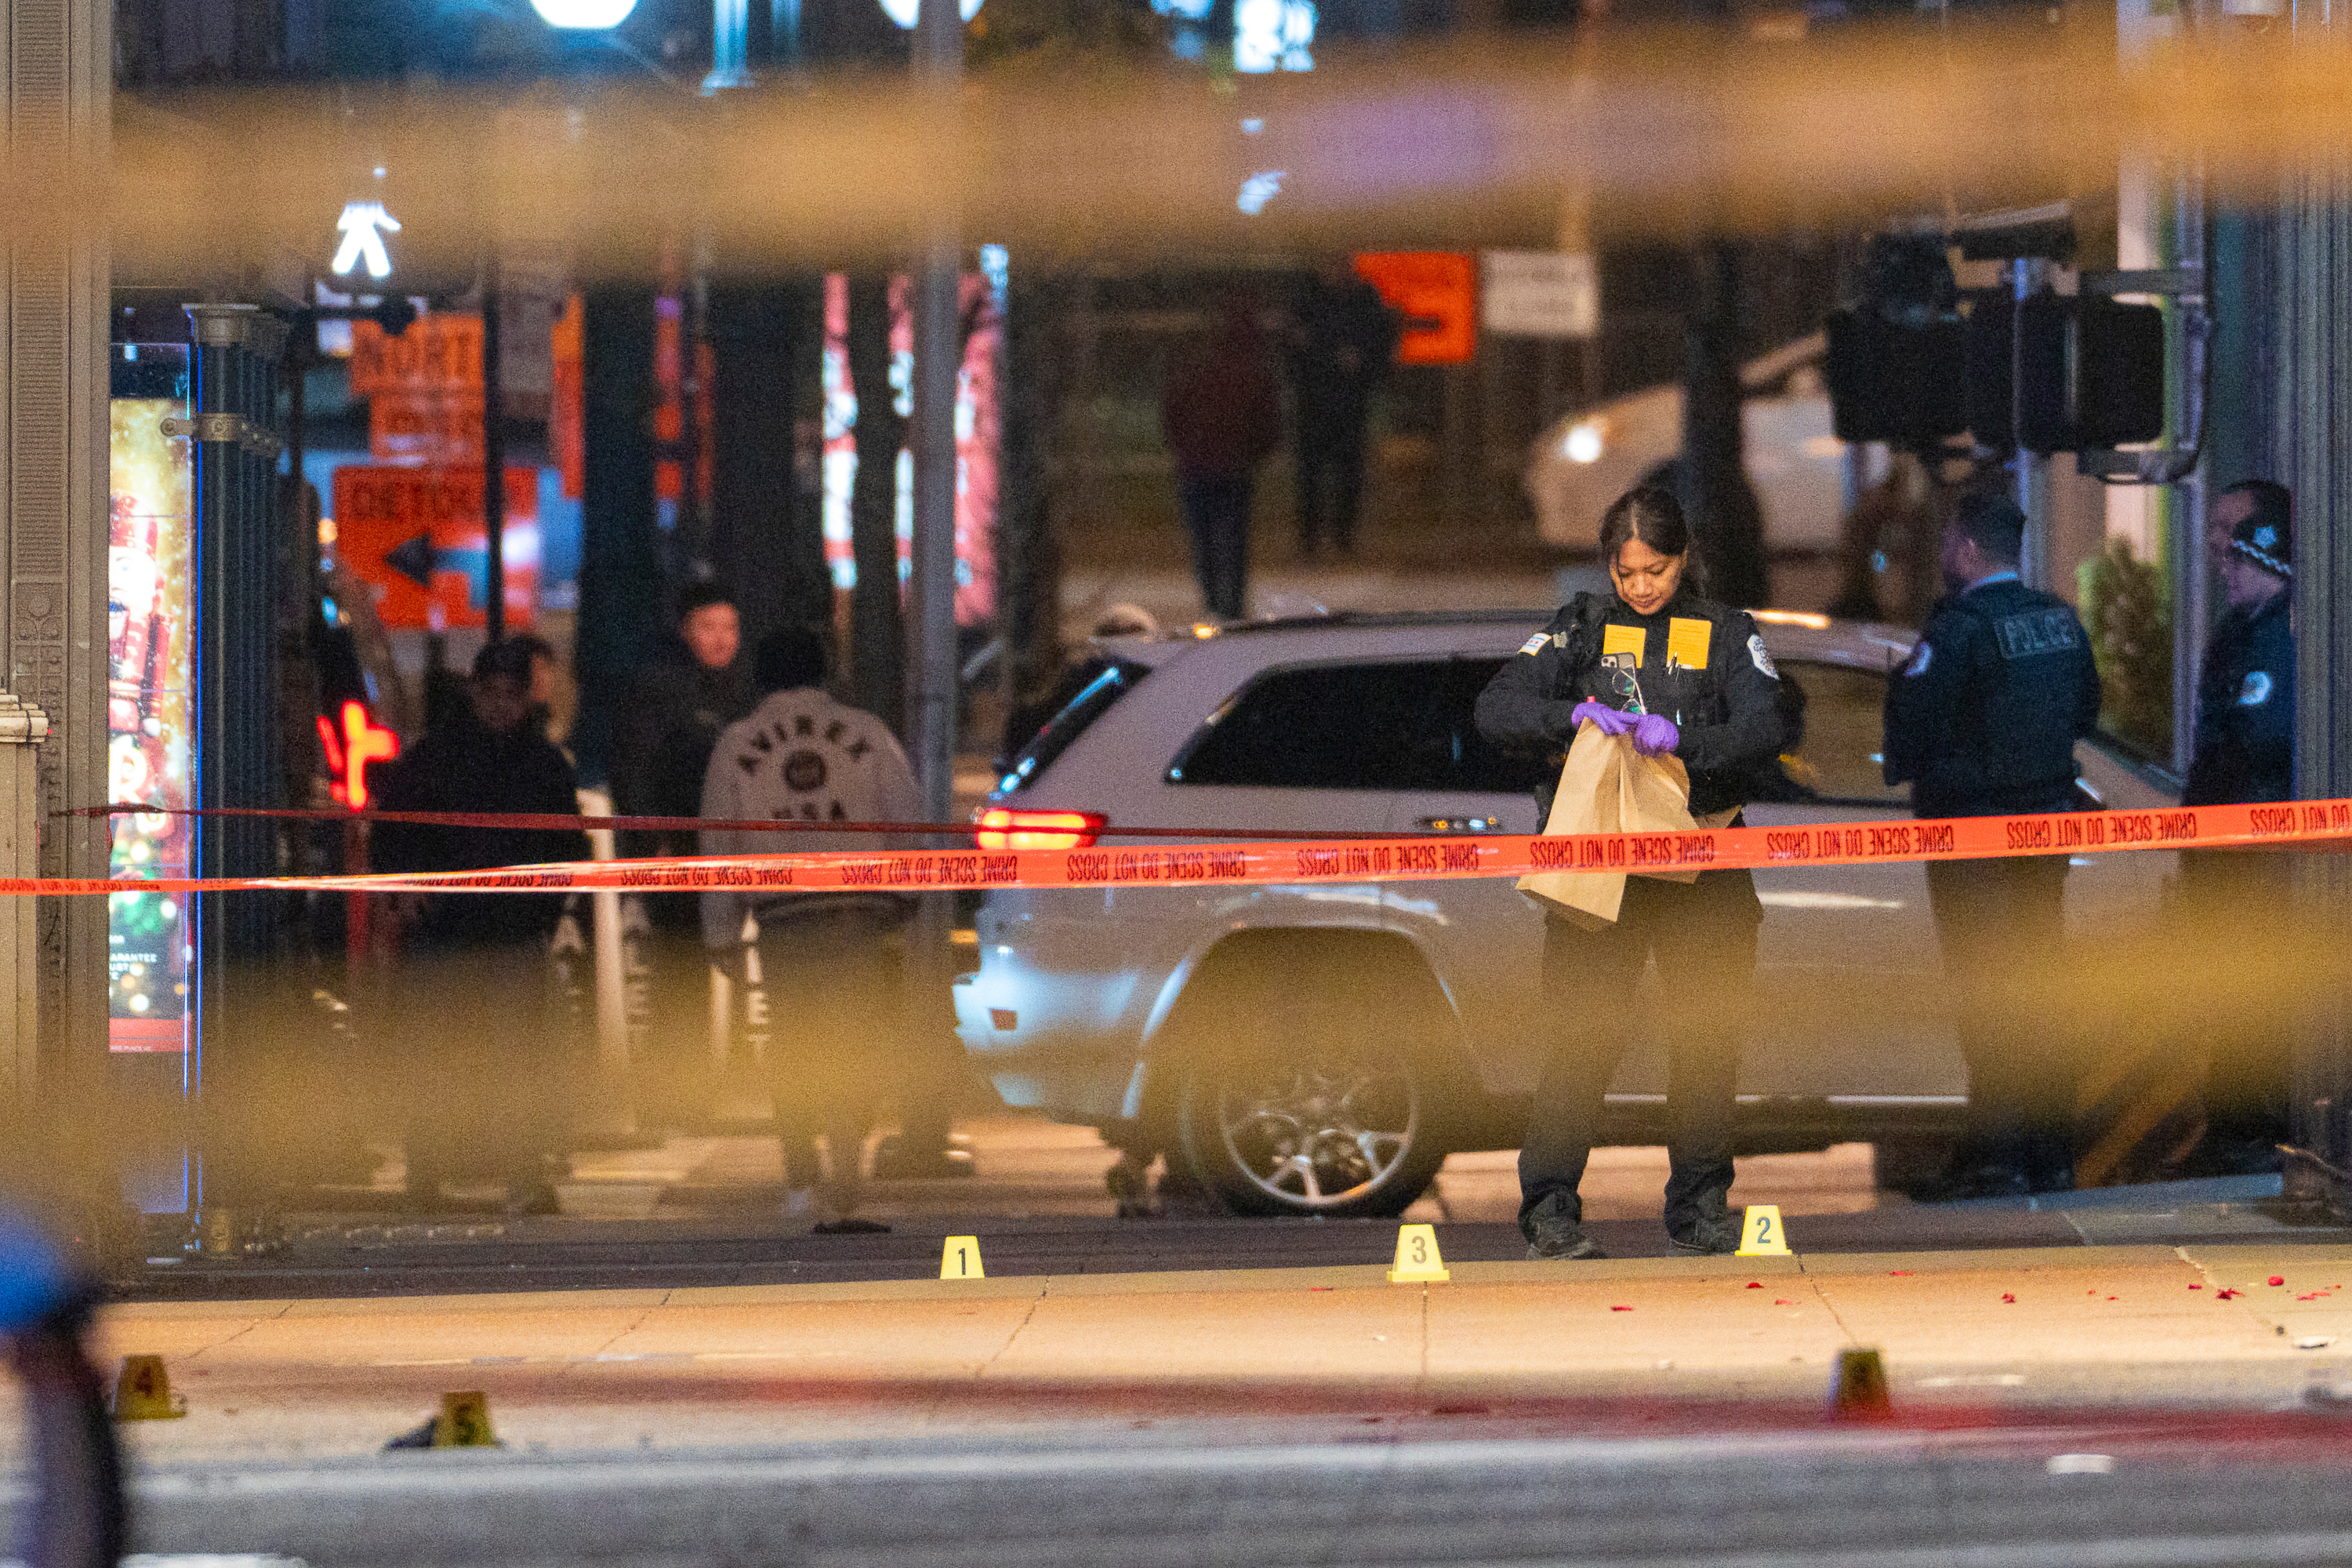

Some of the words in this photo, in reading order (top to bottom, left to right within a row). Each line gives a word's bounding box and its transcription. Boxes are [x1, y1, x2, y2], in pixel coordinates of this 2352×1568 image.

[2003, 612, 2072, 653] POLICE
[2086, 817, 2103, 845] DO
[2109, 815, 2152, 844] SCENE
[2155, 812, 2197, 840] CRIME
[2249, 808, 2296, 836] CROSS
[2302, 806, 2327, 833] NOT
[2332, 804, 2350, 831] DO
[1766, 831, 1810, 860] CROSS
[1815, 829, 1841, 858] NOT
[1846, 829, 1863, 856] DO
[1867, 826, 1911, 855] SCENE
[1914, 825, 1954, 854] CRIME
[2006, 820, 2051, 849] CROSS
[2056, 818, 2082, 847] NOT
[1298, 848, 1339, 876] CROSS
[1344, 848, 1369, 875] NOT
[1374, 847, 1390, 874] DO
[1396, 845, 1437, 874] SCENE
[1441, 843, 1479, 873] CRIME
[1530, 840, 1573, 869] CROSS
[1577, 840, 1603, 868] NOT
[1609, 838, 1624, 867] DO
[1632, 837, 1671, 866] SCENE
[1675, 835, 1715, 863] CRIME
[842, 859, 883, 884] CROSS
[887, 857, 912, 884] NOT
[914, 857, 933, 884] DO
[938, 856, 977, 884] SCENE
[980, 855, 1018, 883] CRIME
[1067, 854, 1109, 881] CROSS
[1112, 853, 1138, 880] NOT
[1142, 853, 1159, 880] DO
[1163, 851, 1204, 879] SCENE
[1208, 850, 1246, 877] CRIME
[110, 953, 158, 963] ARANTEE
[1756, 1216, 1771, 1243] 2
[958, 1247, 966, 1276] 1
[1411, 1236, 1427, 1264] 3
